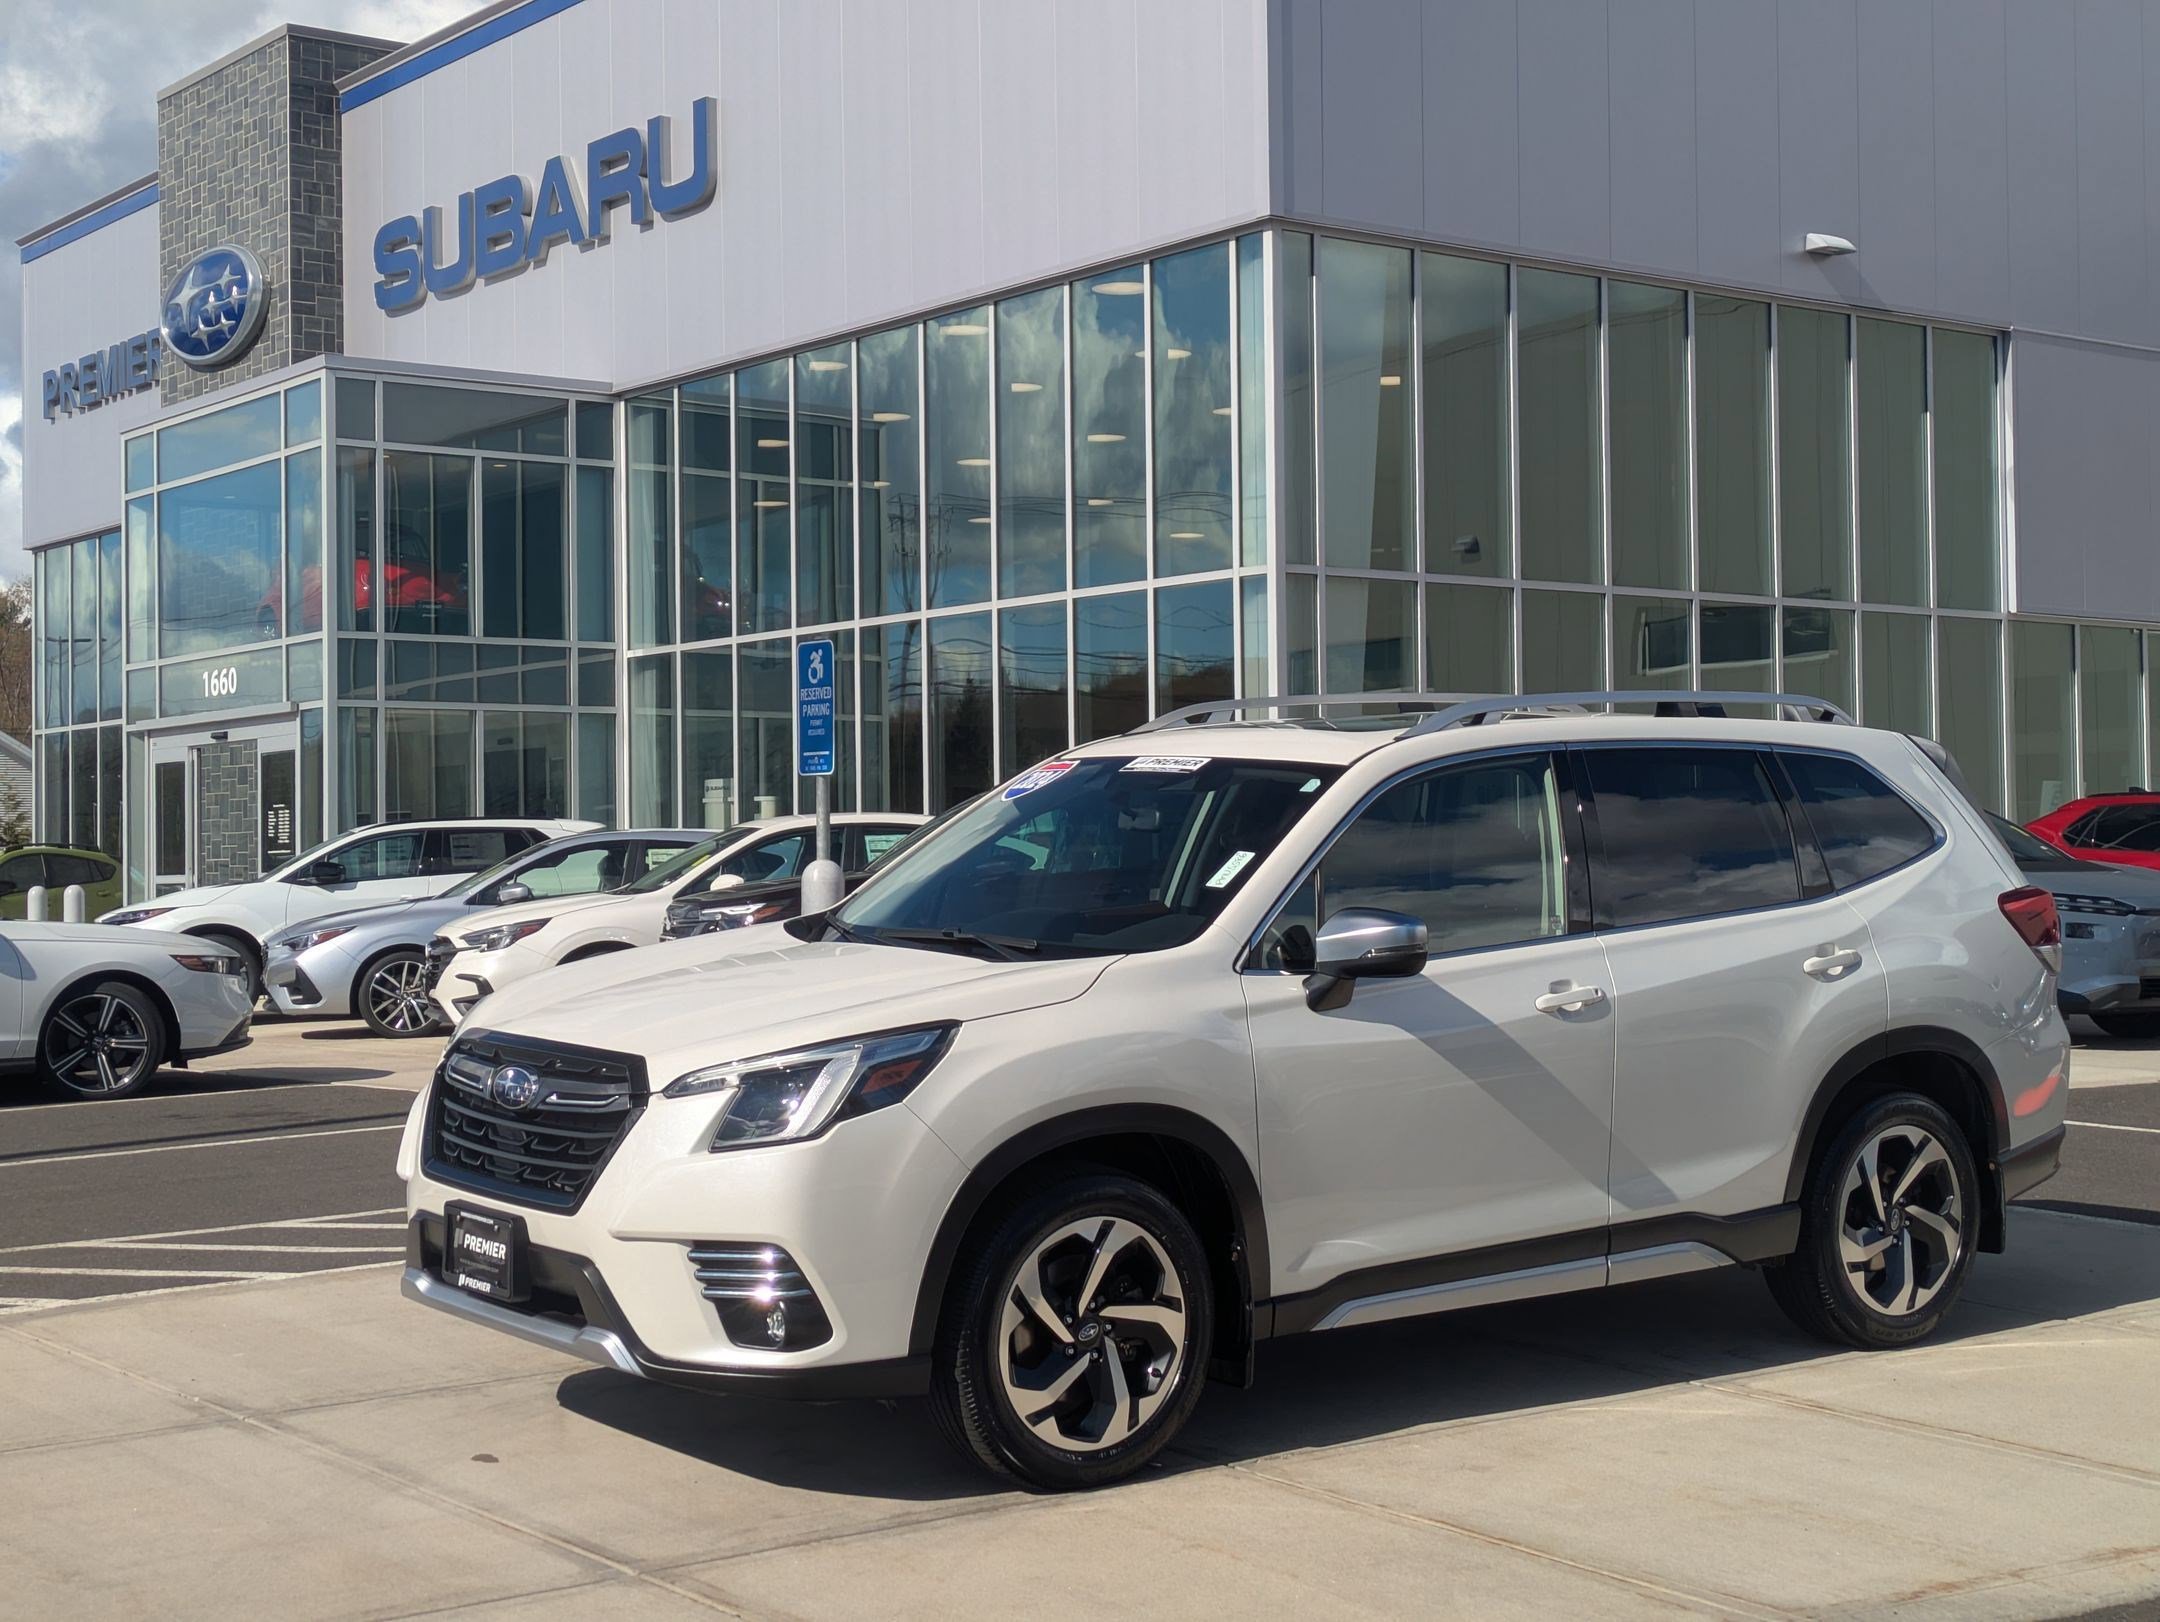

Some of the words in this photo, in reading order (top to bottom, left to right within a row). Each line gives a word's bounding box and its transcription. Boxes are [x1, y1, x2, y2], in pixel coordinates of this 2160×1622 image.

[374, 96, 715, 311] SUBARU
[43, 328, 160, 420] PREMIER
[203, 667, 237, 697] 1660
[800, 686, 832, 701] RESERVED
[802, 702, 830, 717] PARKING
[463, 1233, 507, 1260] PREMIER
[465, 1276, 491, 1293] PREMIER
